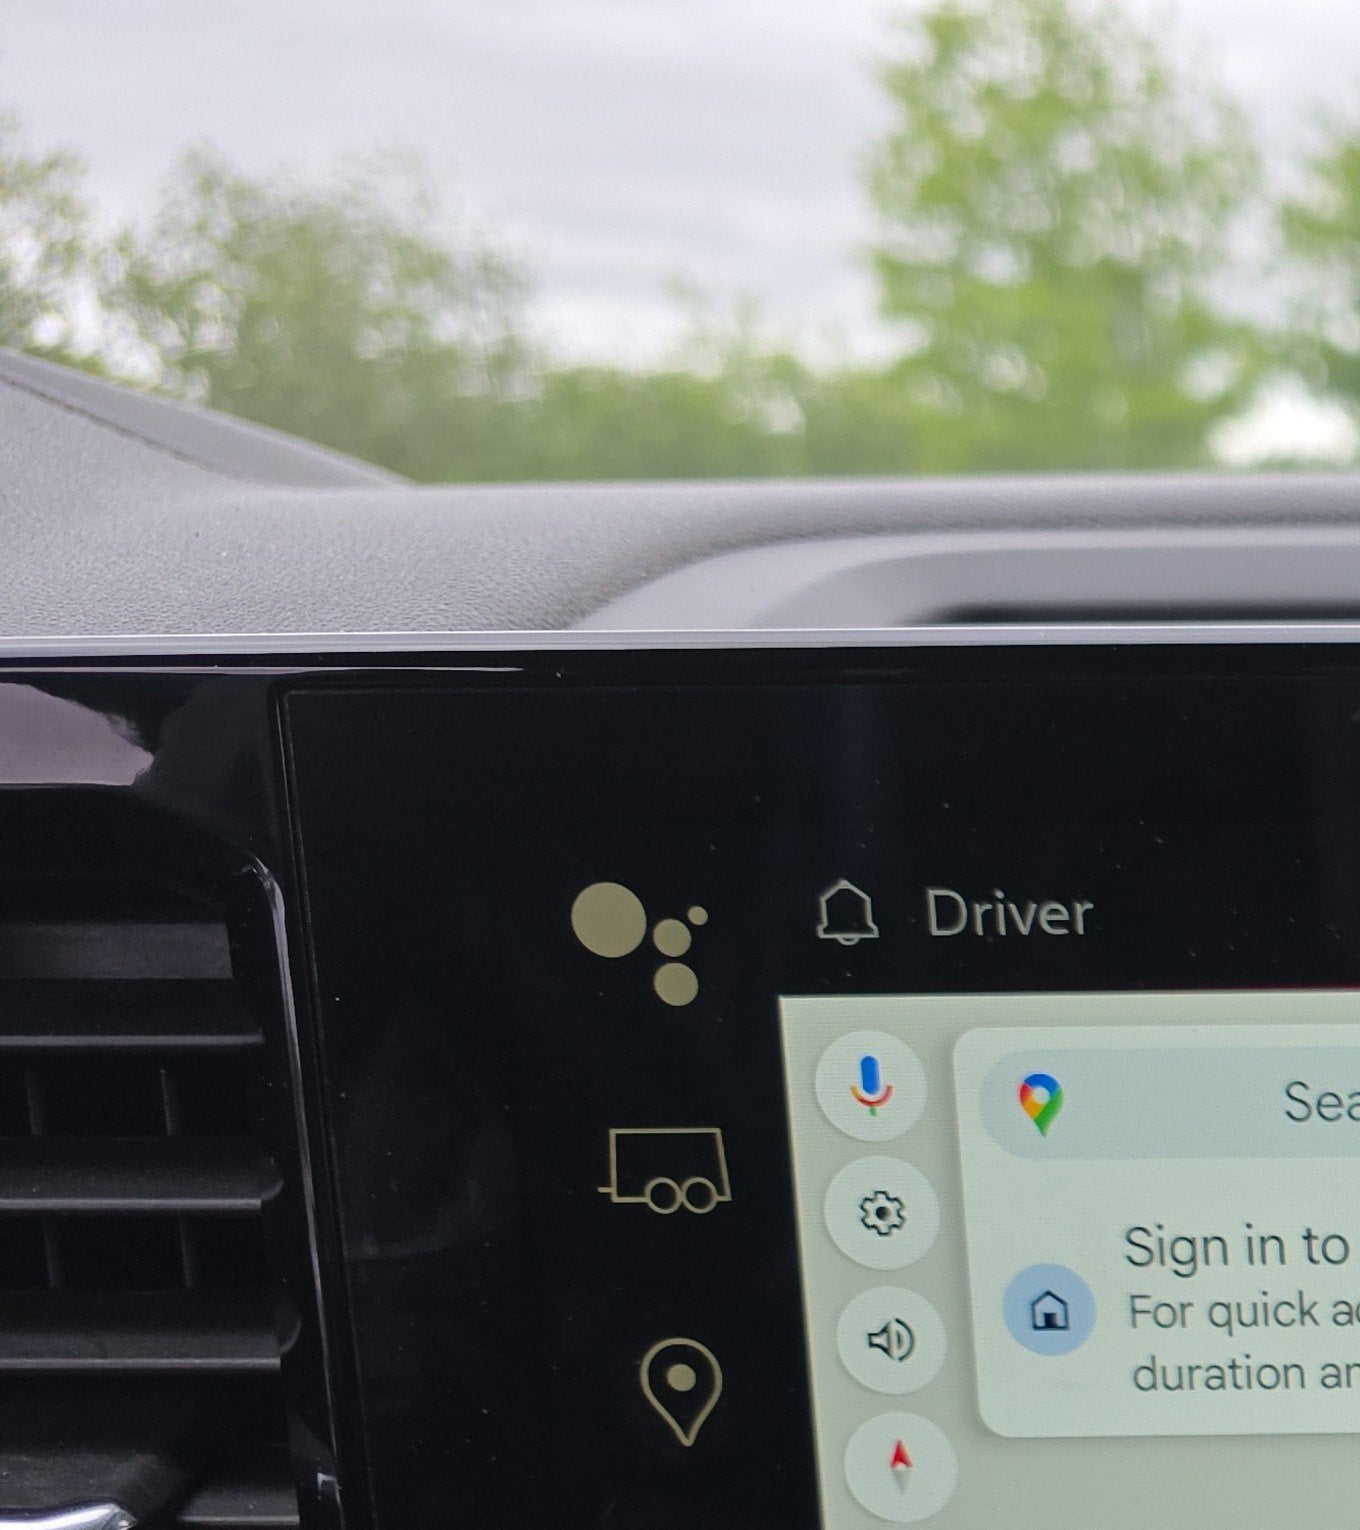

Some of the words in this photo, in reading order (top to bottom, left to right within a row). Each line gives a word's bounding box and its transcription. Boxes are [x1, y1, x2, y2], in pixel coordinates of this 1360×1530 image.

[925, 887, 1095, 937] Driver
[1124, 1223, 1229, 1279] Sign
[1244, 1221, 1287, 1266] in
[1301, 1226, 1350, 1265] to
[1128, 1293, 1195, 1330] For
[1206, 1289, 1321, 1338] quick
[1132, 1352, 1307, 1392] duration
